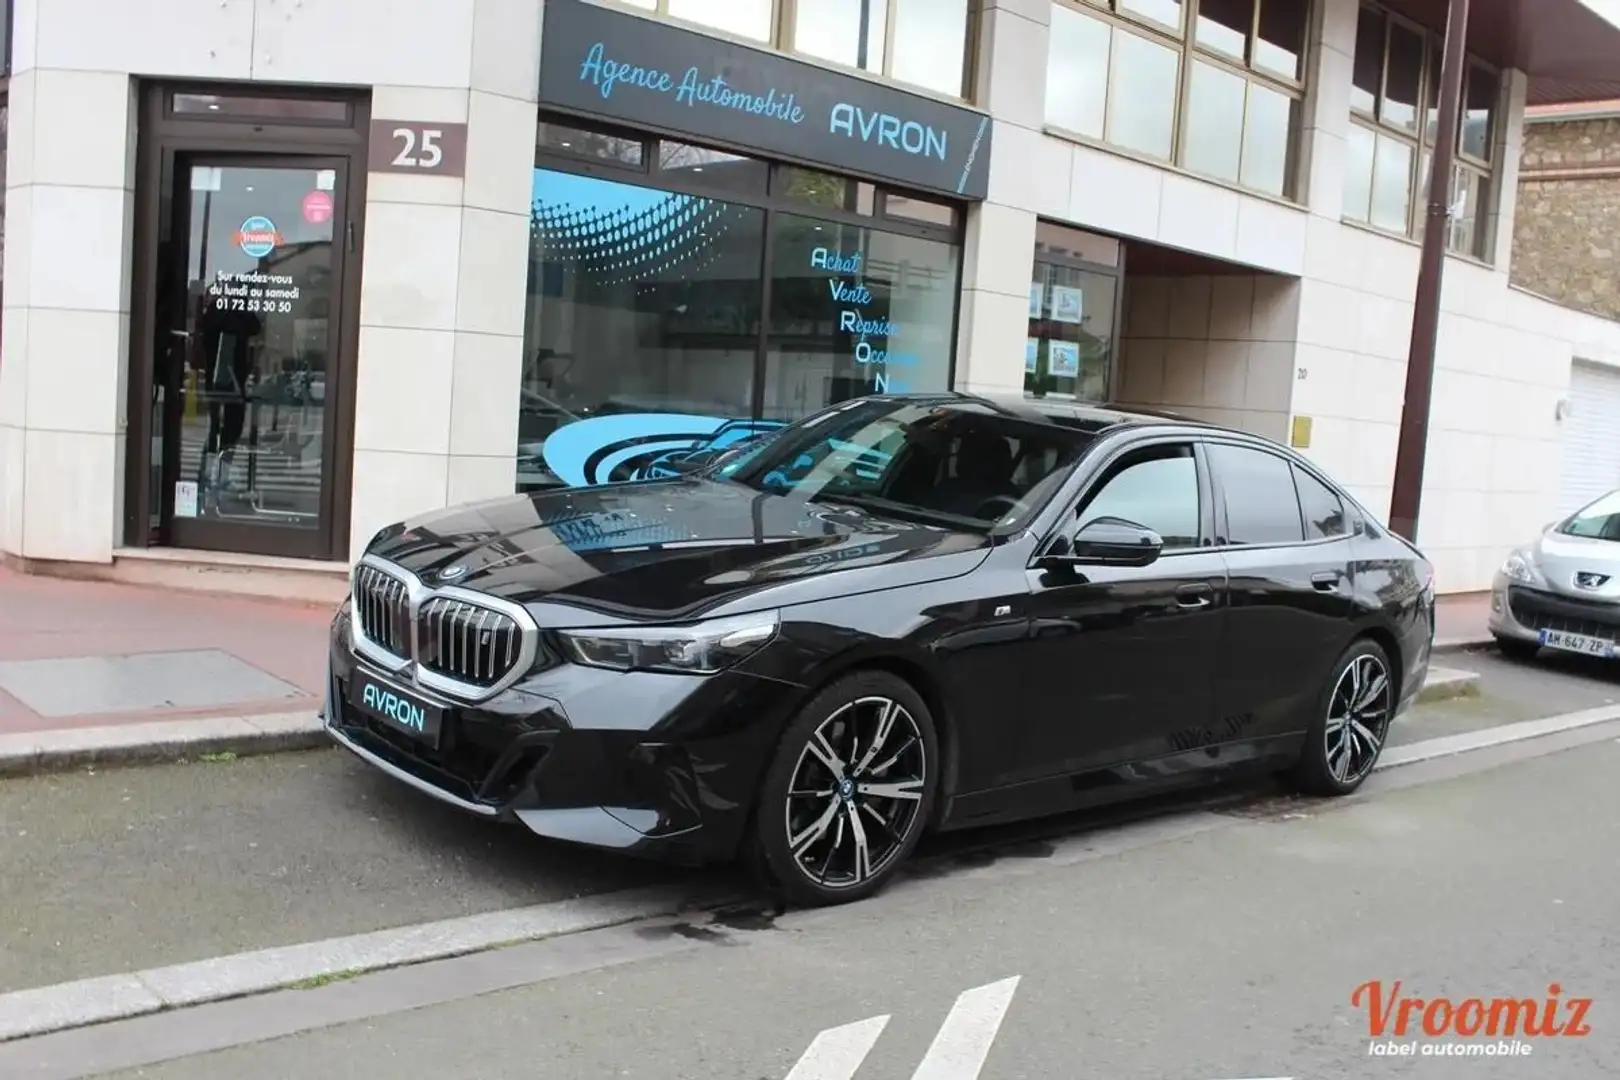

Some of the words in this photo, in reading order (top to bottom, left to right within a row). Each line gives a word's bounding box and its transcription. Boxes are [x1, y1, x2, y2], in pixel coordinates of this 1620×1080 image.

[580, 42, 673, 99] Agence
[676, 67, 804, 124] Automobile
[829, 103, 947, 161] AVRON
[391, 128, 443, 168] 25
[811, 247, 861, 273] Achat
[217, 270, 233, 281] Sur
[236, 271, 293, 284] rendez-vous
[210, 284, 223, 295] du
[225, 284, 248, 296] lundi
[250, 288, 263, 297] au
[265, 287, 300, 299] samedi
[829, 279, 872, 304] Vente
[216, 299, 229, 310] 01
[231, 299, 245, 311] 72
[247, 300, 261, 312] 53
[263, 301, 276, 313] 30
[278, 301, 292, 313] 50
[363, 683, 425, 732] AVRON
